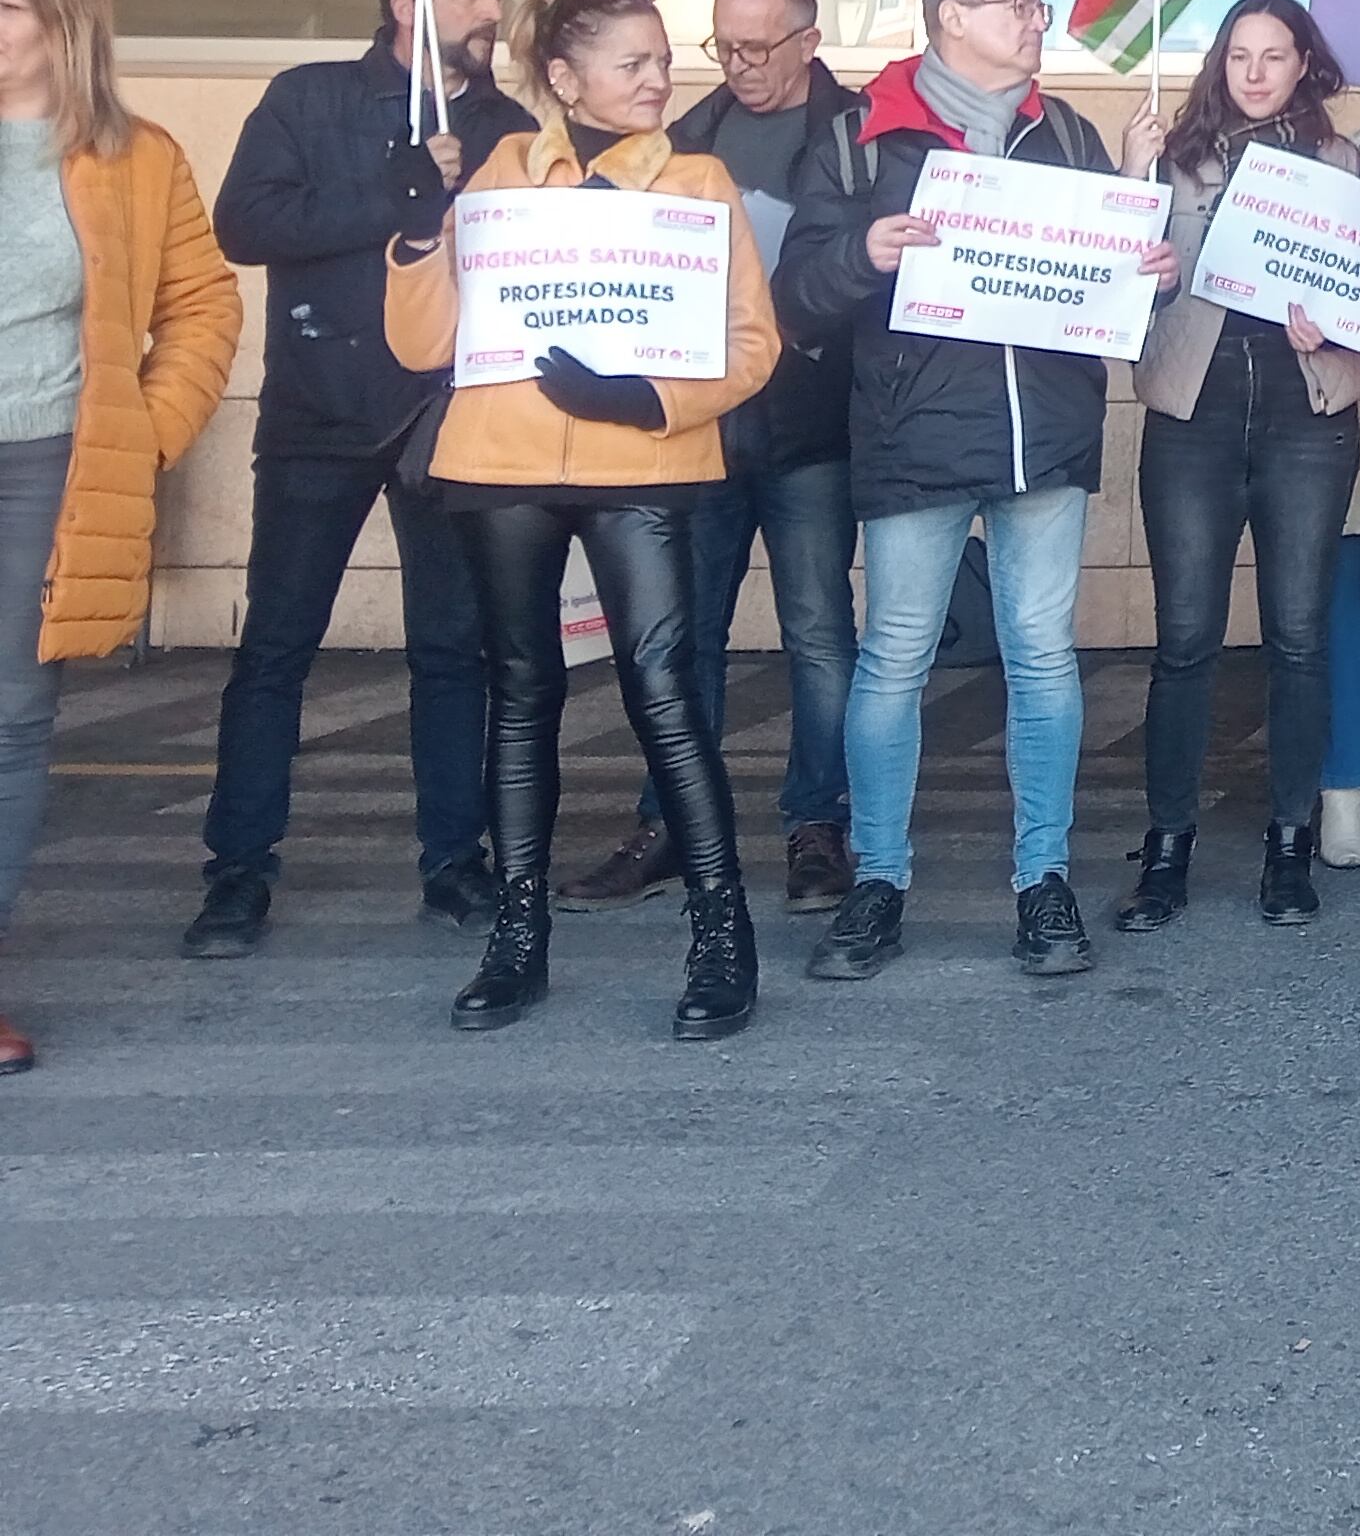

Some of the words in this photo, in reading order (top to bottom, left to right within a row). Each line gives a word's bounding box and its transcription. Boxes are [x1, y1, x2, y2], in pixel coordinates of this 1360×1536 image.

[930, 167, 959, 181] UGT
[463, 211, 490, 225] UGT
[920, 208, 1033, 238] URGENCIAS
[1232, 192, 1330, 233] URGENCIAS
[463, 249, 579, 272] URGENCIAS
[590, 249, 719, 274] SATURADAS
[953, 246, 1111, 284] PROFESIONALES
[971, 276, 1084, 305] QUEMADOS
[1265, 259, 1360, 302] QUEMADOS
[500, 282, 674, 303] PROFESIONALES
[525, 308, 649, 329] QUEMADOS
[1064, 324, 1092, 338] UGT
[635, 347, 666, 359] UGT
